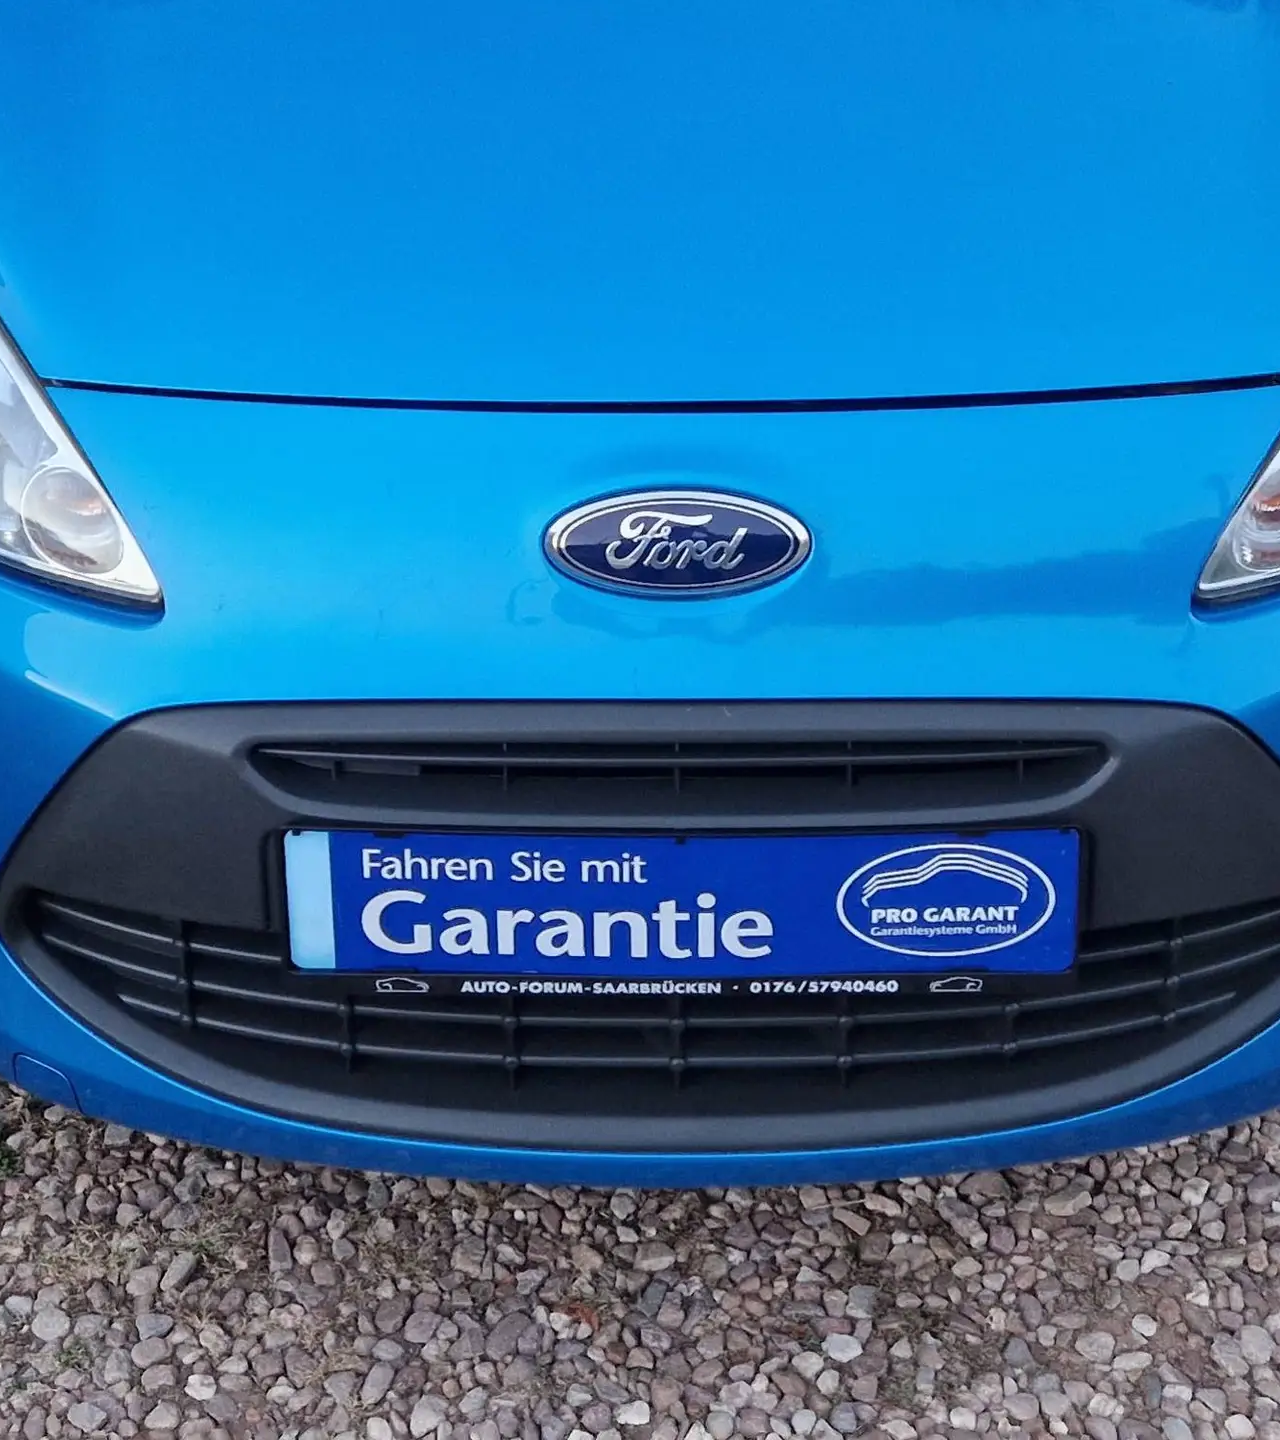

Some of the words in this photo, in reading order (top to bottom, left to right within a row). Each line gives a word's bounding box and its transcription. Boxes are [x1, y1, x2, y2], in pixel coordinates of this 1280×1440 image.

[605, 510, 748, 570] Ford
[361, 847, 493, 881] Fahren
[510, 851, 566, 883] Sie
[580, 852, 648, 884] mit
[360, 889, 774, 960] Garantie
[870, 908, 918, 924] PRO
[922, 905, 1019, 923] GARANT
[870, 925, 973, 938] Garantiesysteme
[975, 923, 1017, 935] GmbH
[749, 979, 899, 994] 0176/57940460
